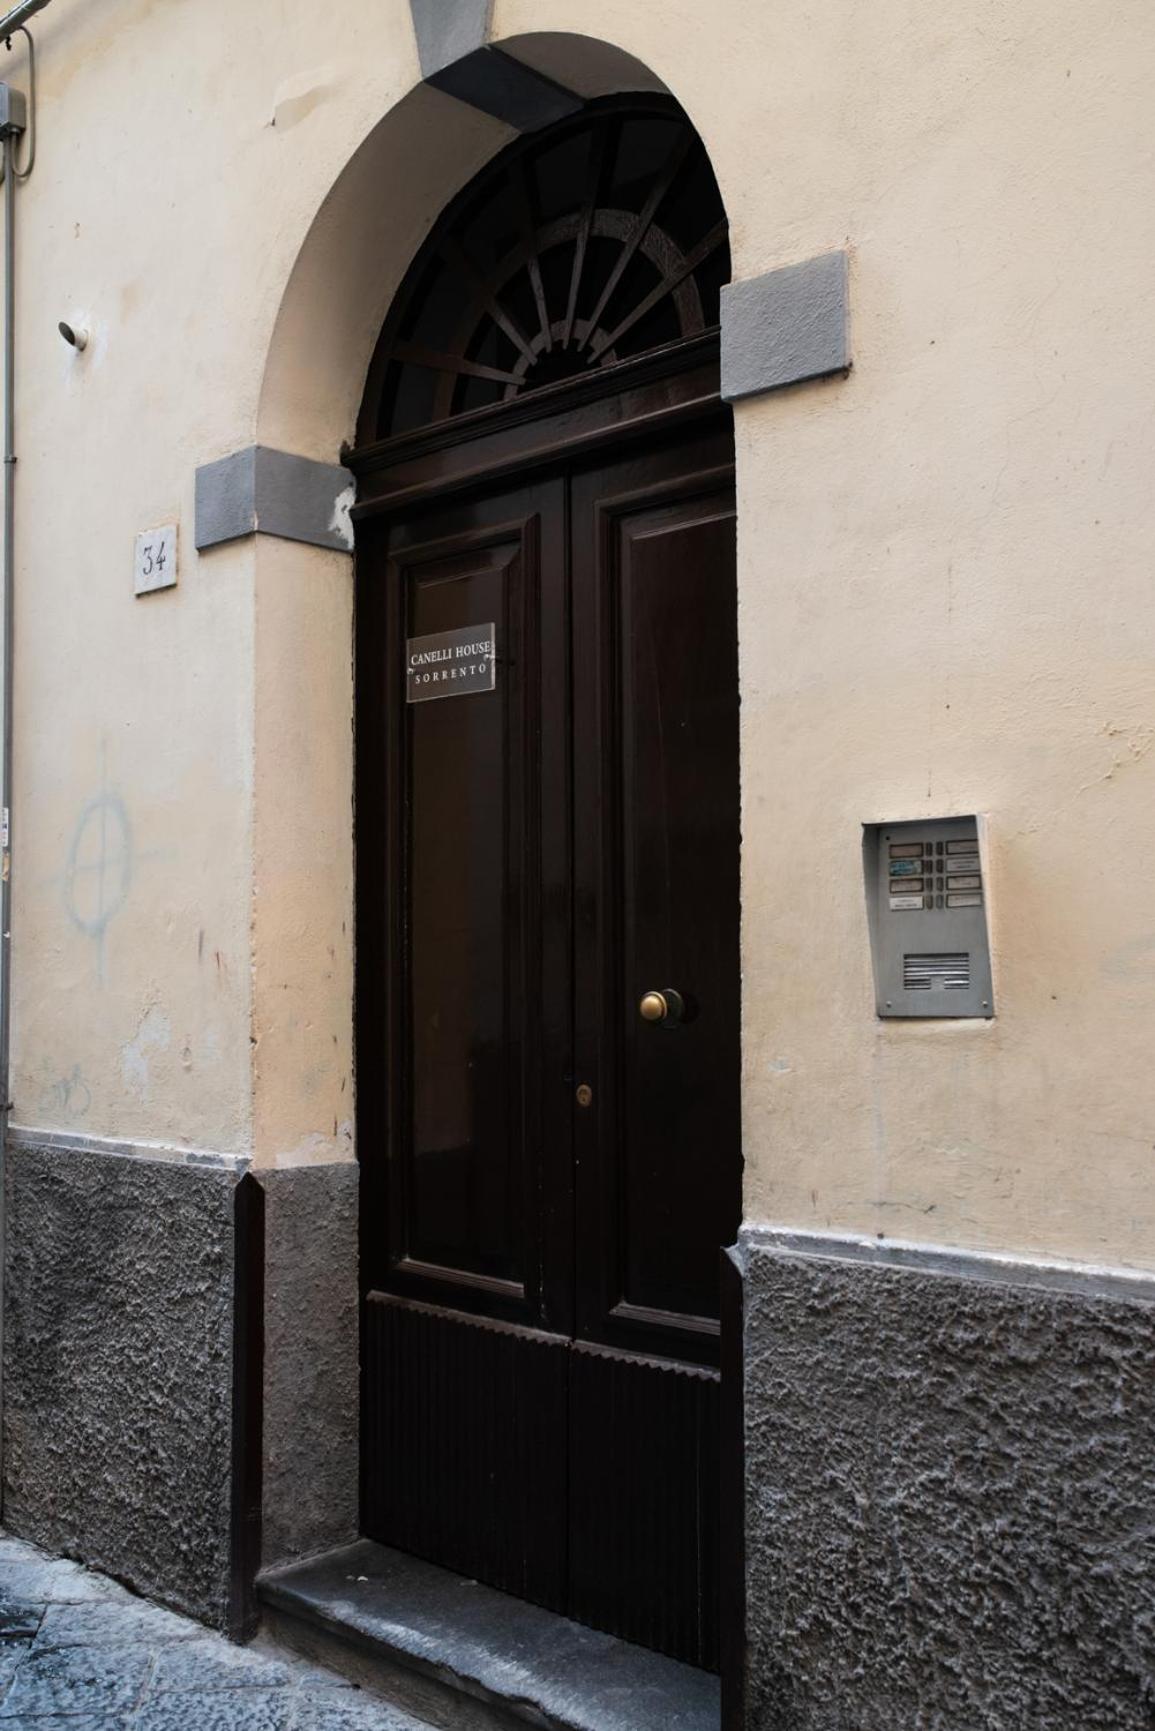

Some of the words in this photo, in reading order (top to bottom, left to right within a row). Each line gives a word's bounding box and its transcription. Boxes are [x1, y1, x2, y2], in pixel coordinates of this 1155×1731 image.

[143, 541, 166, 575] 34
[411, 647, 452, 665] CANELLI
[456, 641, 490, 658] HOUSE
[415, 663, 486, 684] SORRENTO
